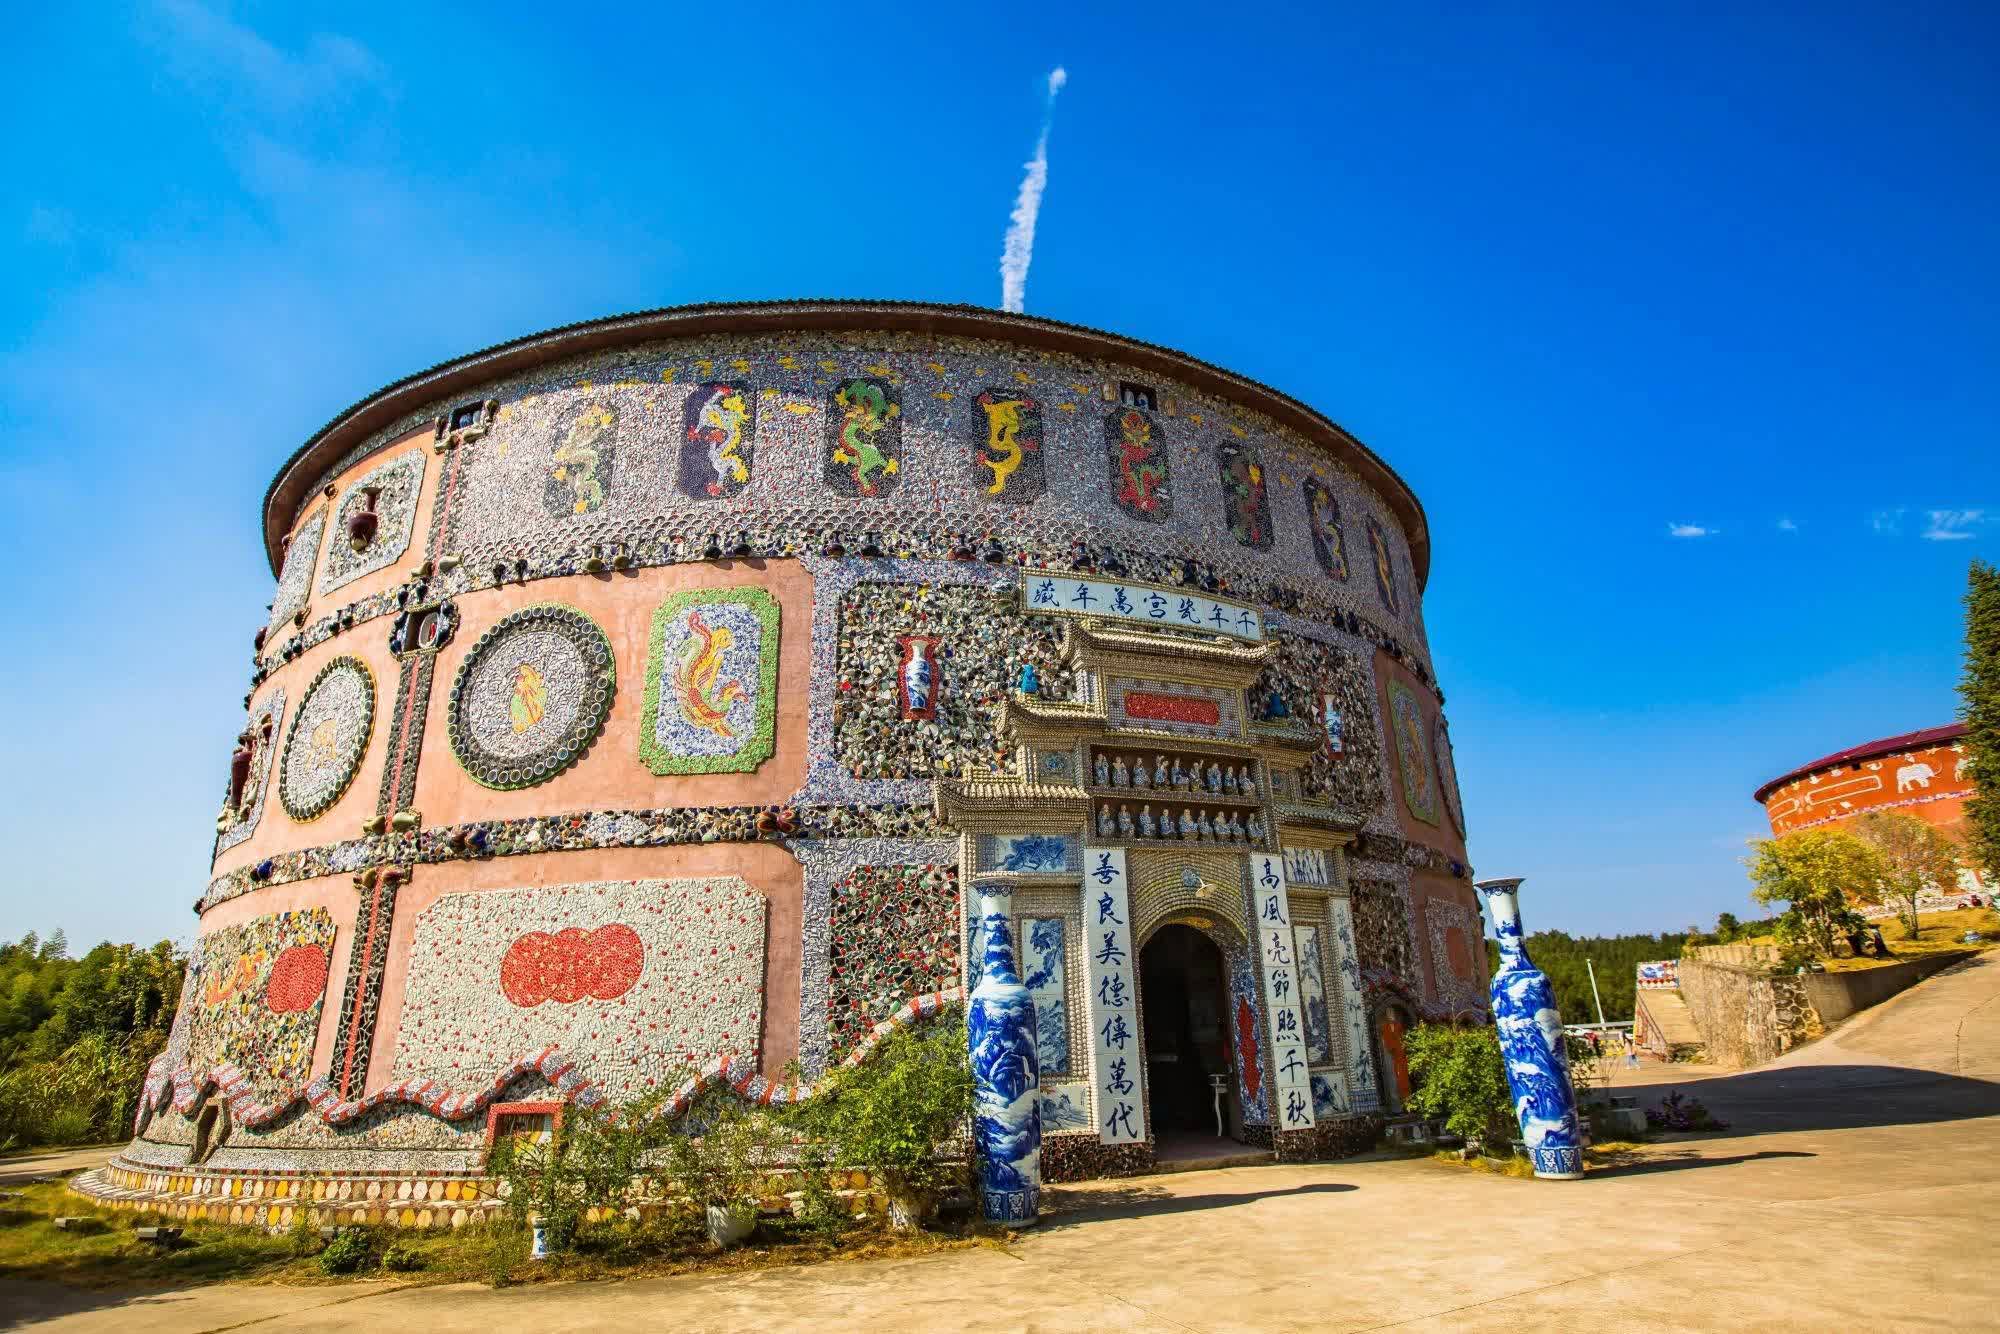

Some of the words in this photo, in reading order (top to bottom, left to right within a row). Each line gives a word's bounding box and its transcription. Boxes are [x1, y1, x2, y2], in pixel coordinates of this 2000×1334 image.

[1091, 851, 1139, 1139] 善良美德傳萬代
